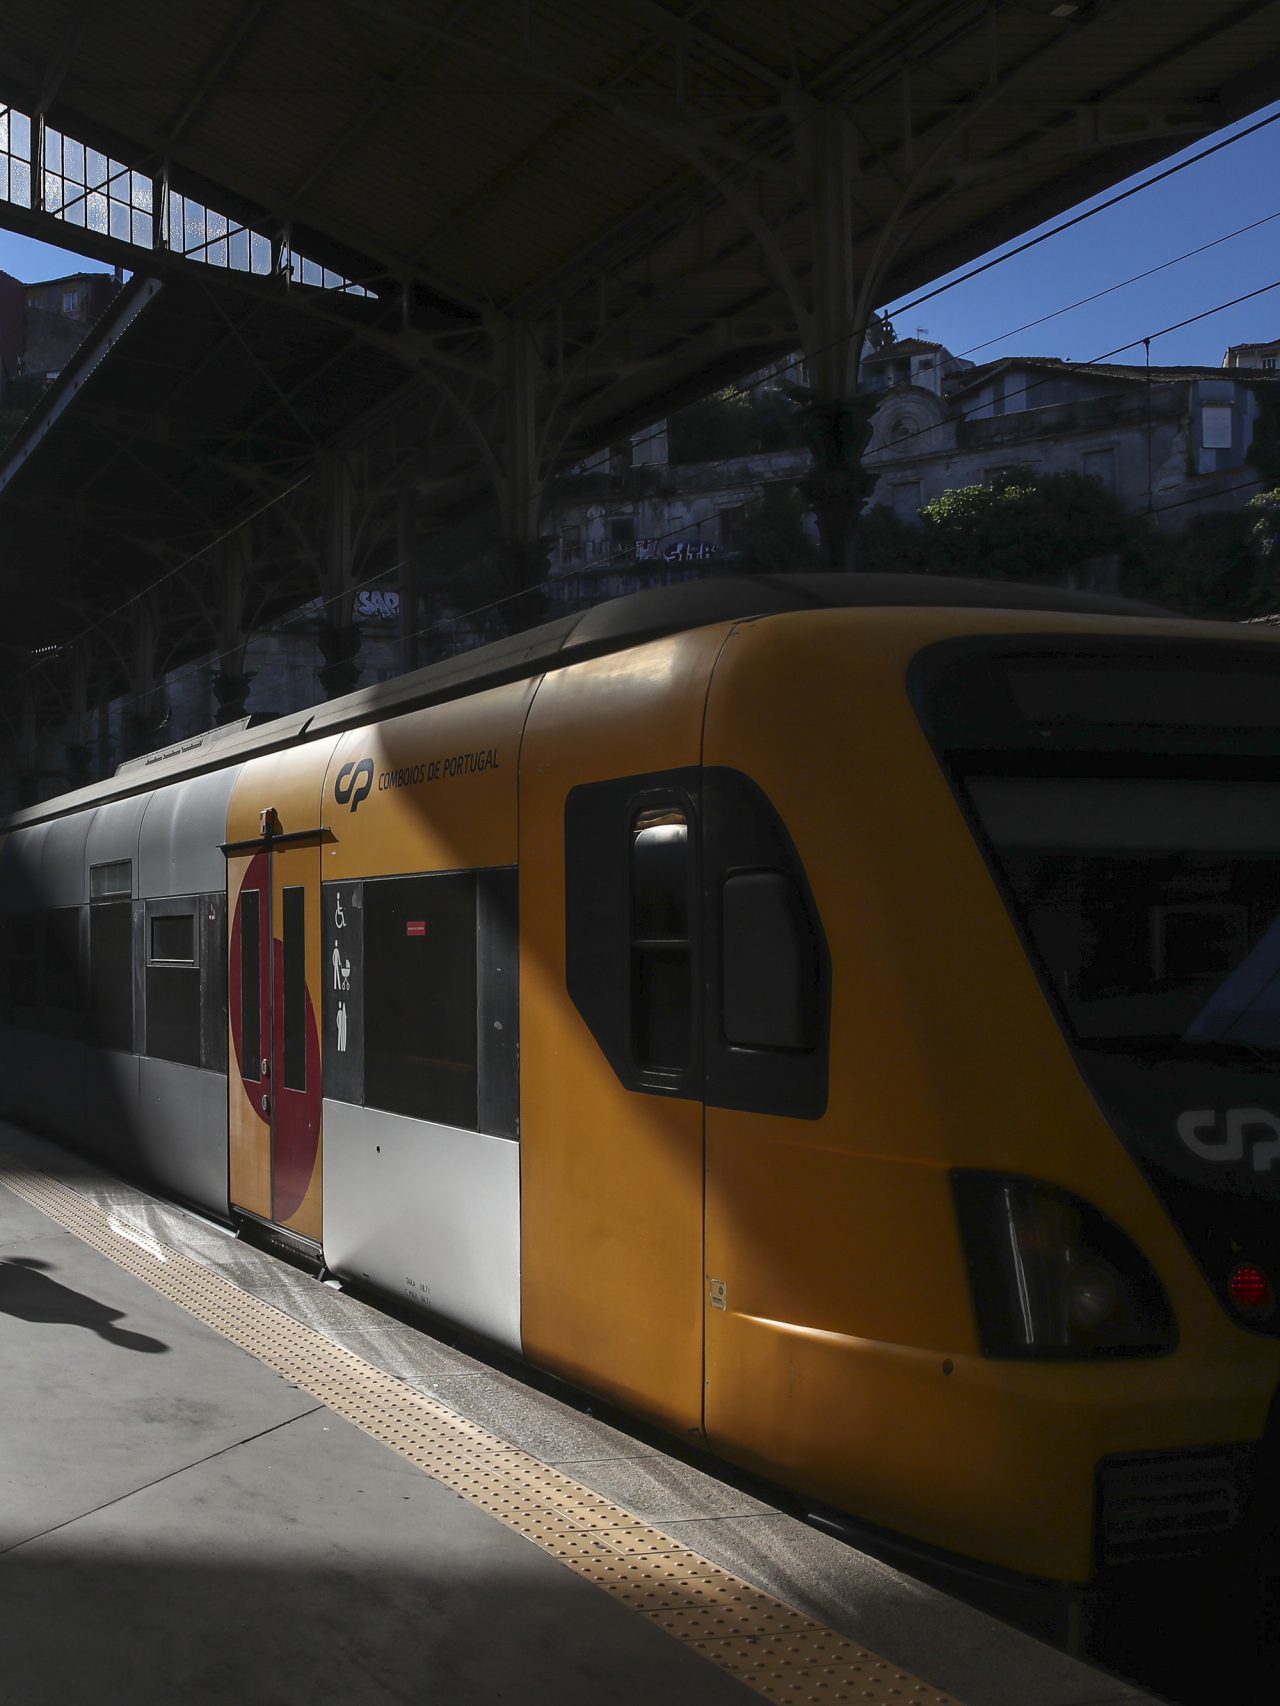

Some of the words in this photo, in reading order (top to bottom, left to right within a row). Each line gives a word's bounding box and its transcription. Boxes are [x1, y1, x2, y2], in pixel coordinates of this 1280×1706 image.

[378, 764, 425, 791] COMBOIOS
[427, 760, 440, 781] DE
[442, 748, 499, 778] PORTUGAL
